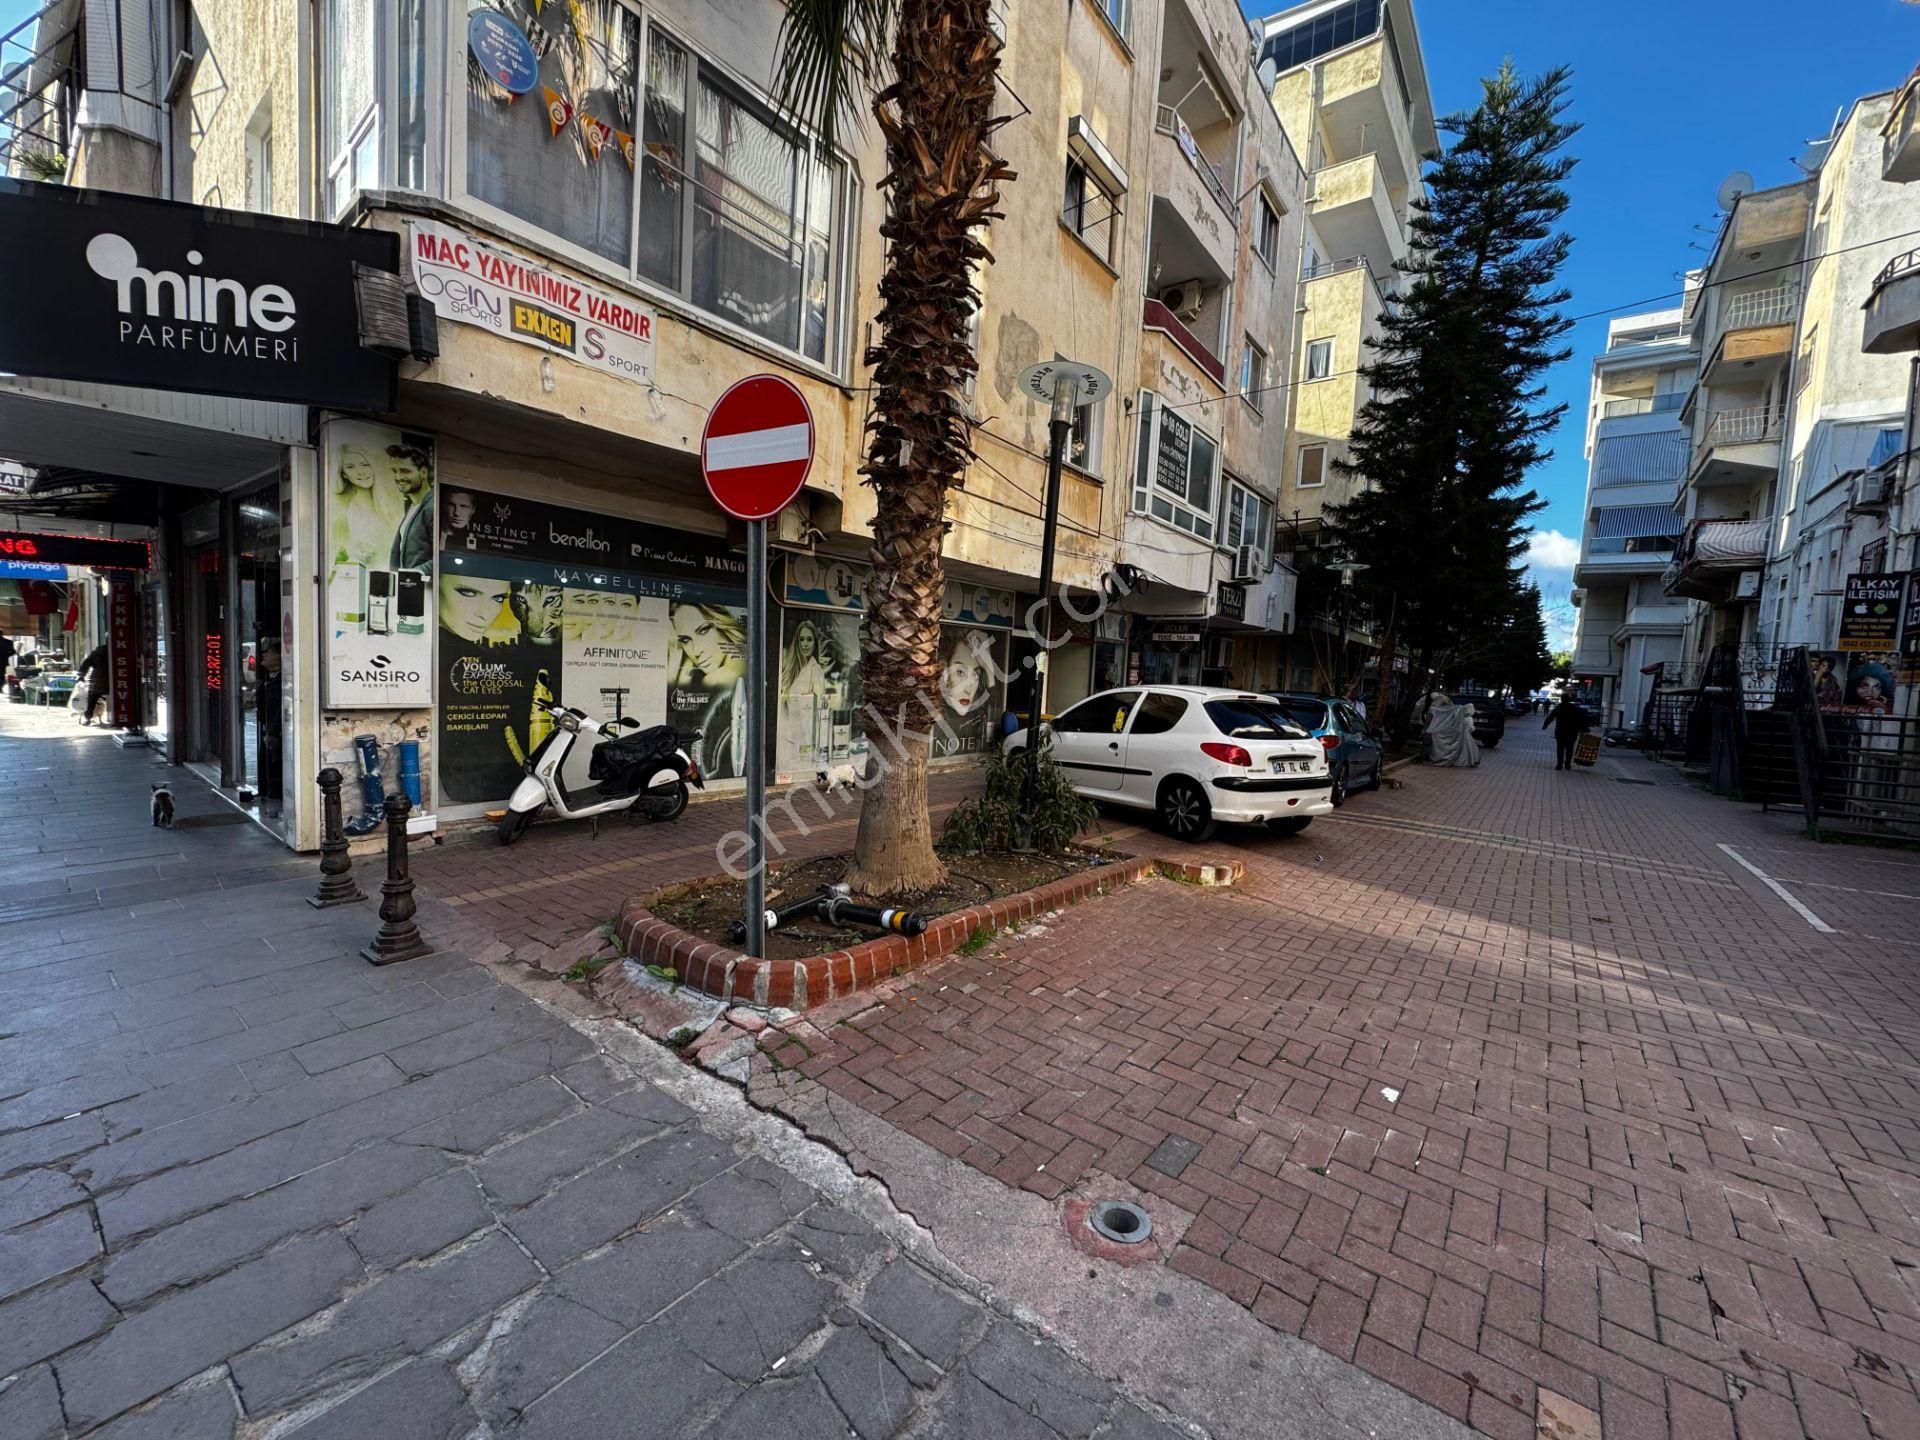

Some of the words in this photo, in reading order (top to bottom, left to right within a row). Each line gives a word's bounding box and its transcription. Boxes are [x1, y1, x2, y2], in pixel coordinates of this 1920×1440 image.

[86, 233, 296, 332] mine
[417, 233, 470, 271] MAÇ
[475, 251, 581, 313] YAYINIMIZ
[587, 293, 651, 339] VARDIR
[450, 300, 502, 328] SPORTS
[514, 304, 573, 347] EXXEN
[119, 320, 298, 363] PARFÜMERİ
[608, 354, 649, 377] SPORT
[466, 522, 537, 541] INSTINCT
[8, 559, 61, 573] piyango
[704, 555, 745, 573] MANGO
[554, 567, 683, 593] MAYBELLINE
[584, 647, 649, 660] AFFINITONE
[463, 671, 513, 680] EXPRESS
[463, 679, 478, 687] the
[479, 679, 524, 688] COLOSSAL
[476, 712, 507, 720] LEOPAR
[446, 723, 489, 731] BAKIŞLARI
[935, 736, 976, 753] NOTE
[1289, 761, 1297, 773] TL
